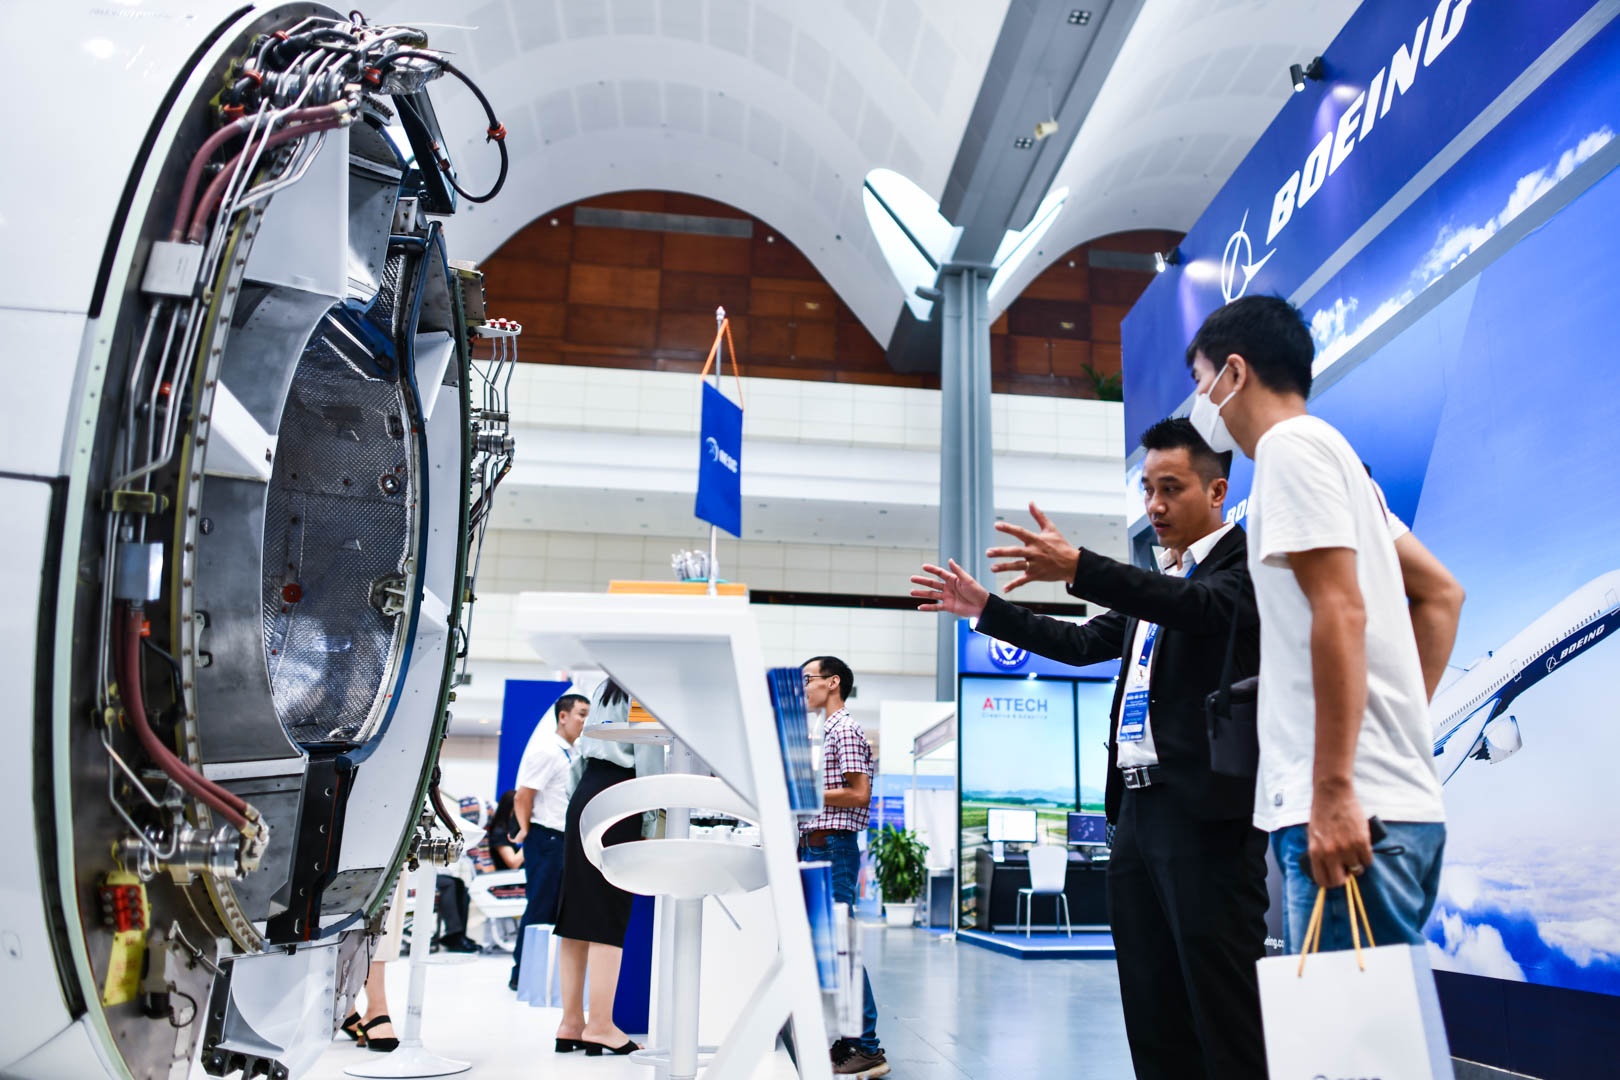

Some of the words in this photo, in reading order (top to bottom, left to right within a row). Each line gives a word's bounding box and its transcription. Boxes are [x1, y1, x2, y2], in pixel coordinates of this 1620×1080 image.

[1266, 0, 1472, 245] BOEING
[1560, 624, 1605, 660] BOEING
[982, 697, 1048, 712] ATTECH
